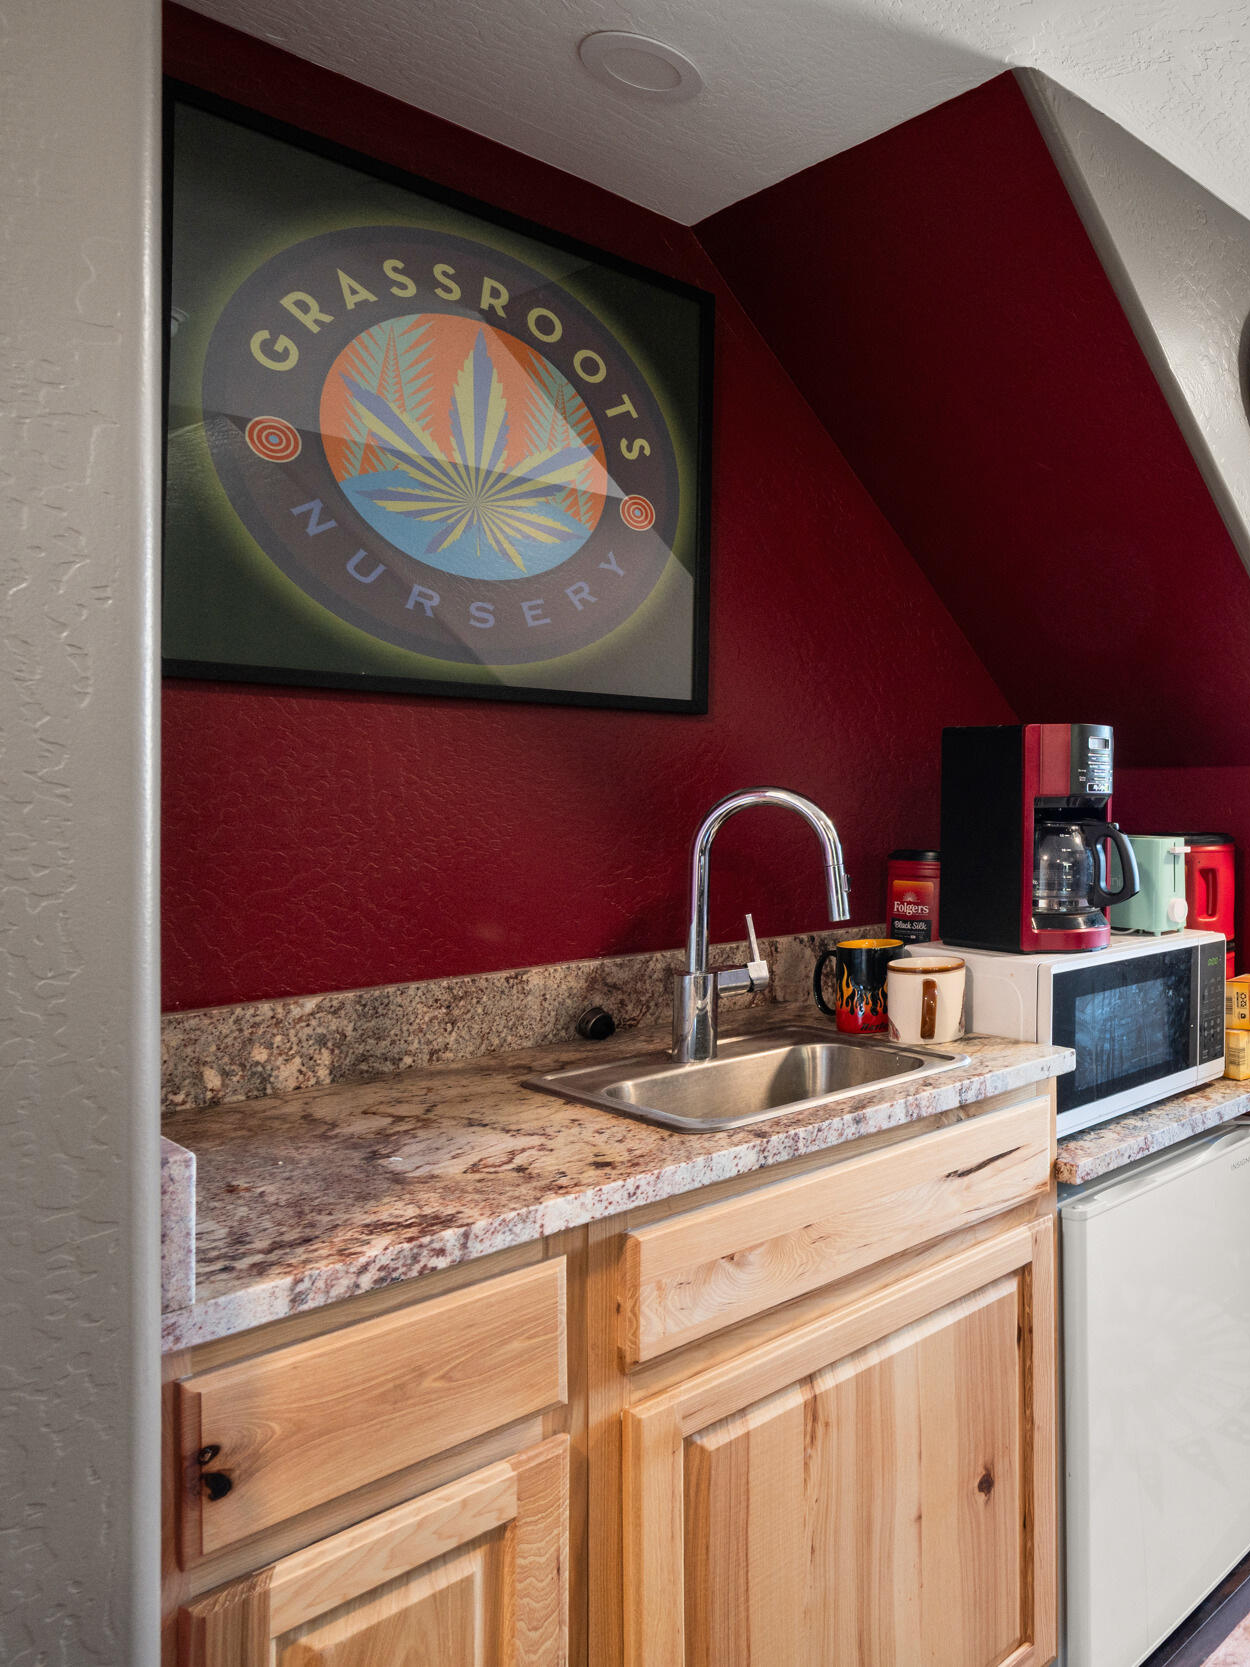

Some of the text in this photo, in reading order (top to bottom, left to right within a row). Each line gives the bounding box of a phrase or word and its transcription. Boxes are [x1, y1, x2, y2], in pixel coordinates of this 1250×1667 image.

[249, 258, 651, 461] GRASSROOTS
[290, 499, 626, 630] NURSERY
[893, 901, 930, 916] Folgers
[894, 920, 928, 930] Black Silk
